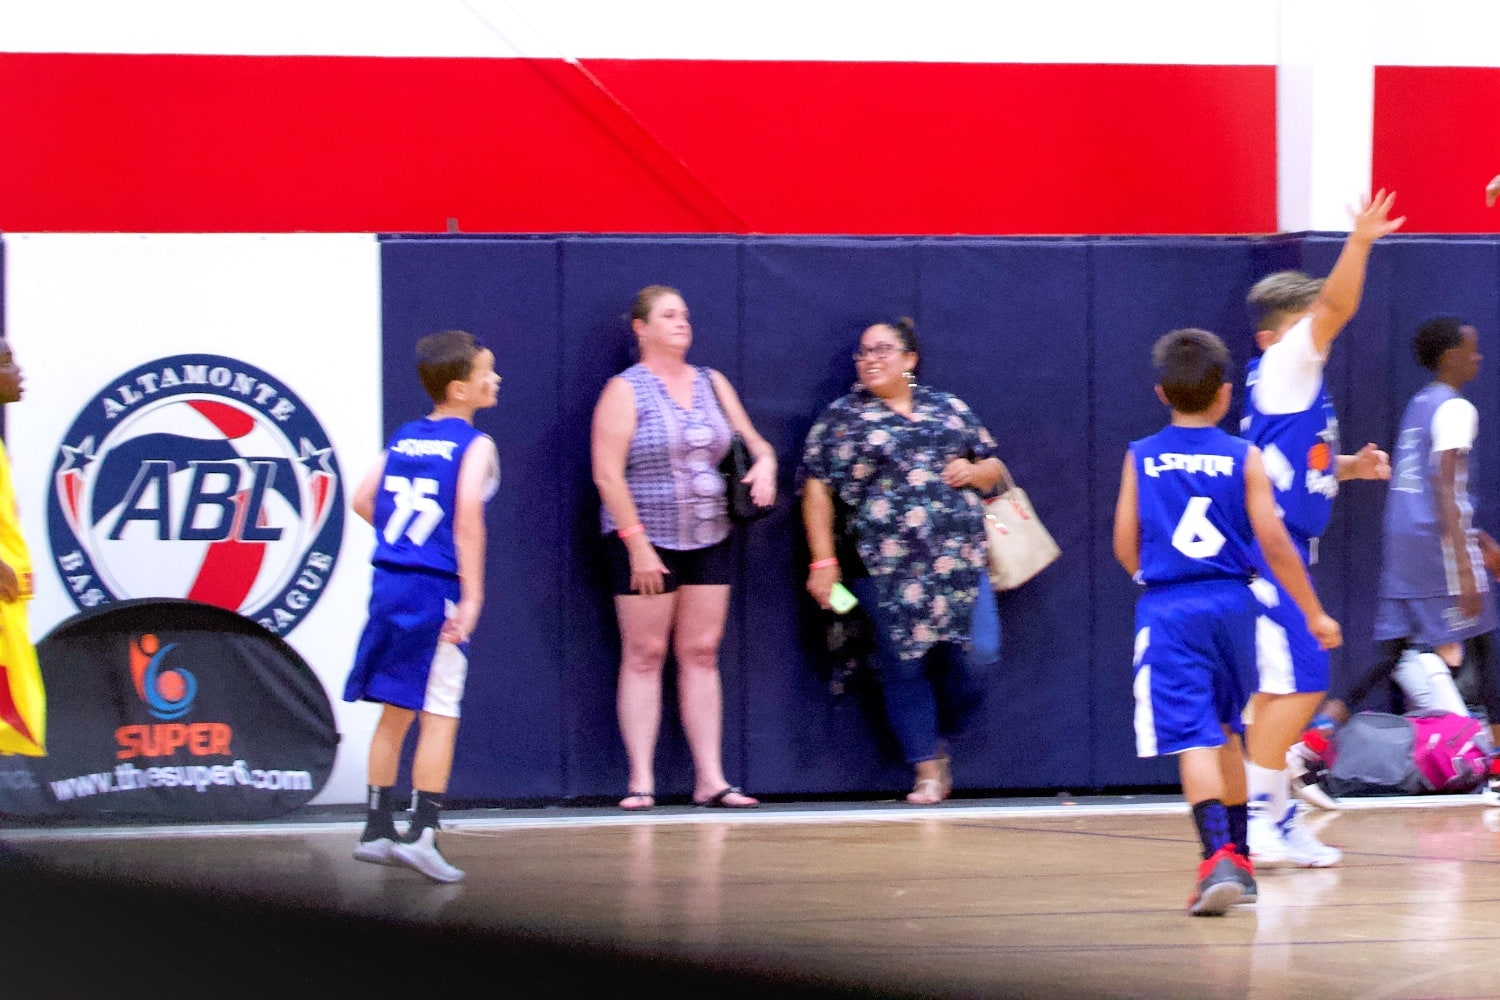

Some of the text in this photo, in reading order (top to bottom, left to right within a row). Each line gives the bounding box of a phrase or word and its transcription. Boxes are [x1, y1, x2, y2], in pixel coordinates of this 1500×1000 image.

[102, 364, 296, 421] ALTAMONTE
[106, 458, 285, 542] ABL
[1171, 496, 1227, 559] 6
[114, 722, 233, 760] SUPER
